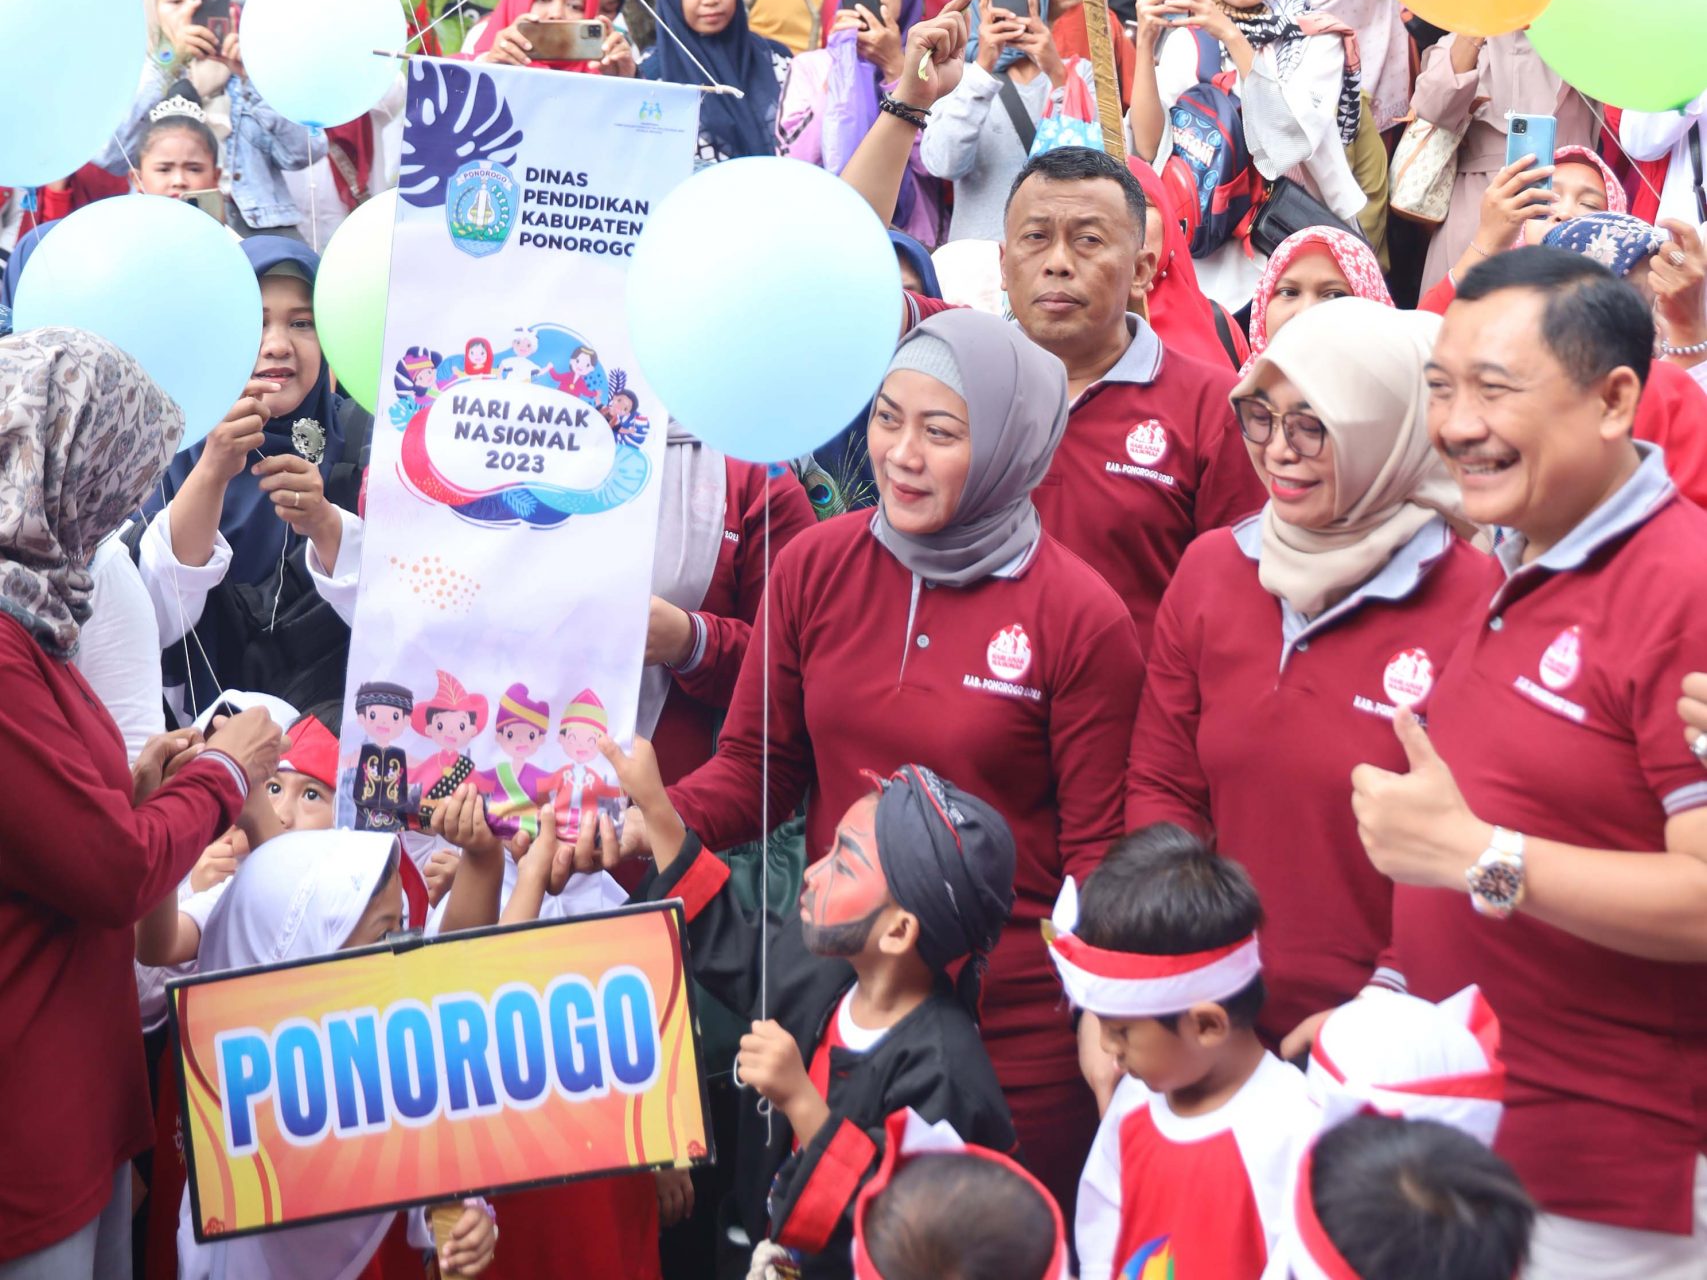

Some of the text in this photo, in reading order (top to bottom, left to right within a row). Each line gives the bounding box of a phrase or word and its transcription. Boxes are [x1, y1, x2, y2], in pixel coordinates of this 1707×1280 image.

[463, 170, 507, 183] PONOROGO
[525, 167, 588, 188] DINAS
[523, 189, 649, 215] PENDIDIKAN
[521, 210, 643, 236] KABUPATEN
[452, 395, 590, 428] HARI ANAK
[454, 421, 580, 451] NASIONAL
[485, 449, 545, 474] 2023
[1106, 461, 1122, 473] KAB.
[1122, 464, 1159, 480] PONOROGO
[963, 674, 982, 688] KAB.
[982, 678, 1024, 697] PONOROGO
[219, 971, 658, 1149] PONOROGO
